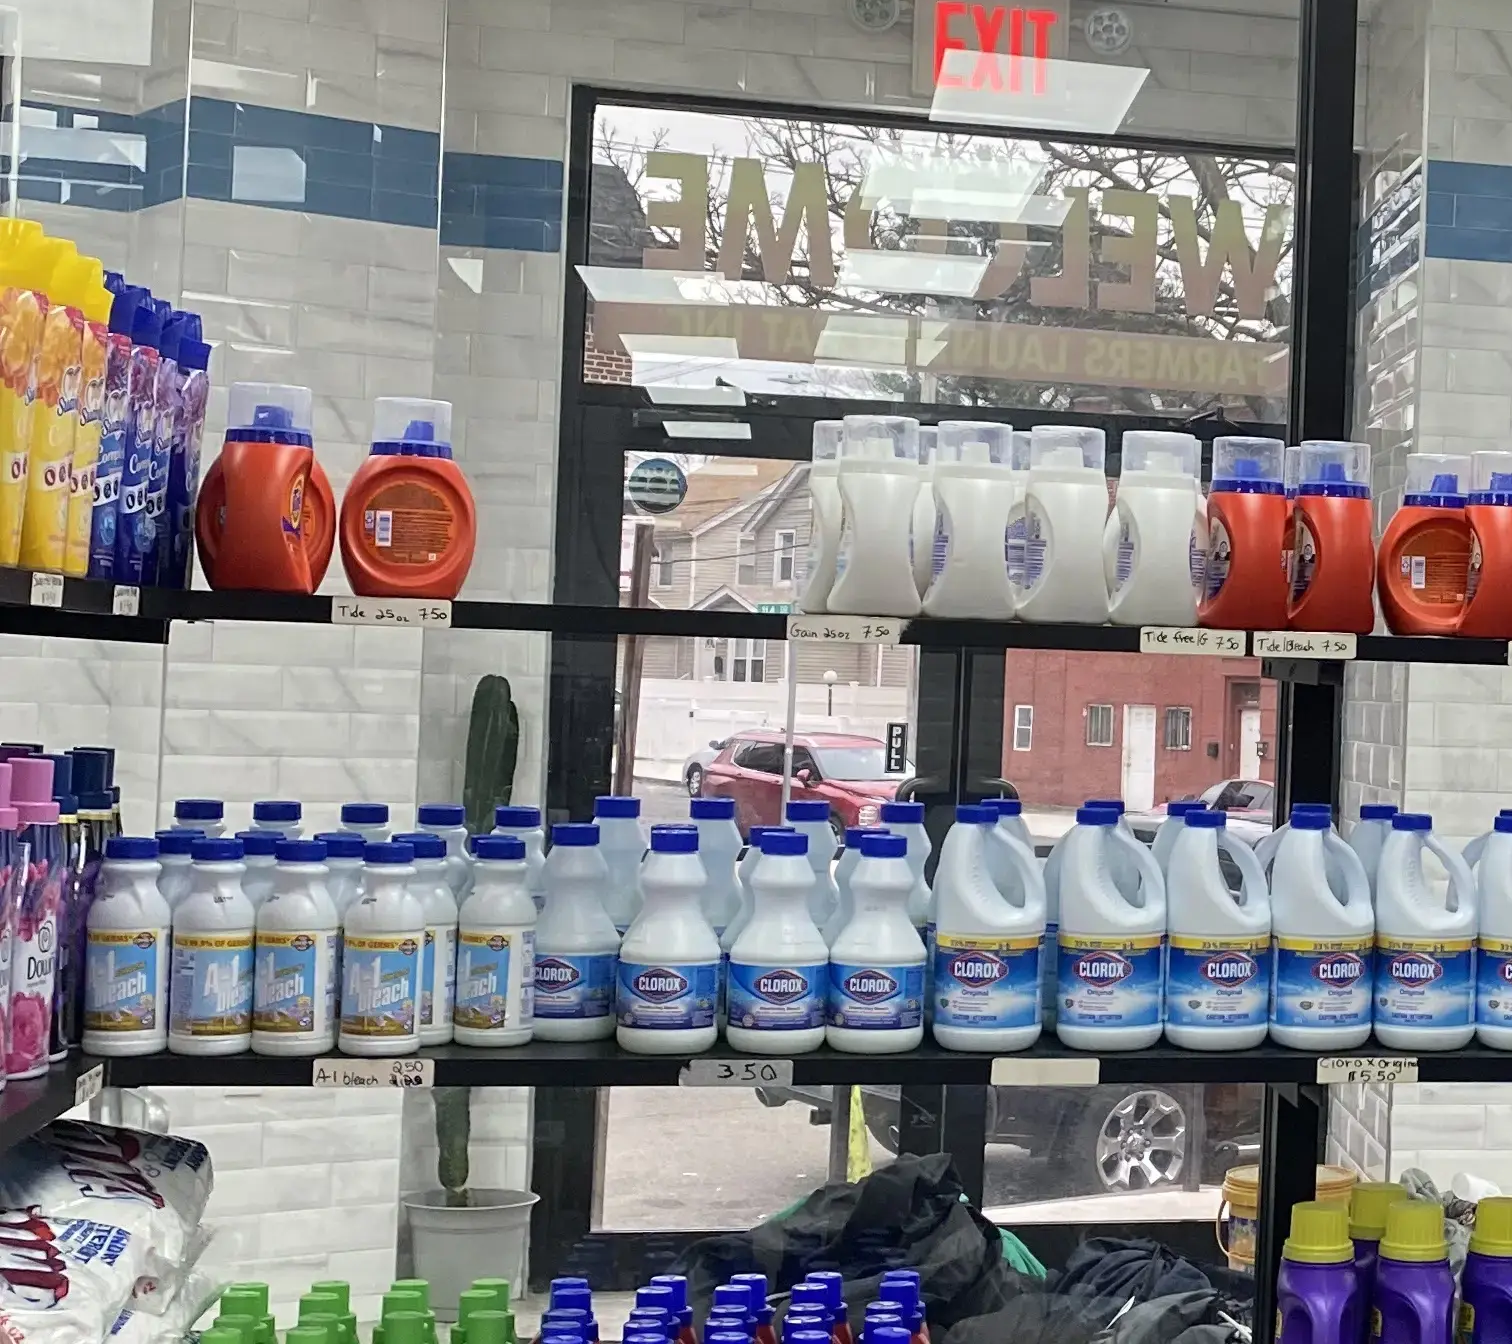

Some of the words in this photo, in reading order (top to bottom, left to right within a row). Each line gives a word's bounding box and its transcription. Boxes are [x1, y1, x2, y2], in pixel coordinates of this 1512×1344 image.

[933, 0, 1058, 95] EXIT
[337, 604, 366, 618] Tide
[790, 622, 818, 638] Gain
[1144, 631, 1168, 644] Tide
[891, 724, 903, 773] PULL
[953, 961, 1000, 978] CLOROX
[1079, 961, 1125, 978] CLOROX
[1207, 960, 1252, 978] CLOROX
[1318, 960, 1362, 979] CLOROX
[1391, 960, 1437, 979] CLOROX
[638, 976, 681, 992] CLOROX
[760, 978, 803, 993] CLOROX
[849, 977, 892, 993] CLOROX
[314, 1067, 338, 1083] A-1
[343, 1072, 379, 1085] bleach
